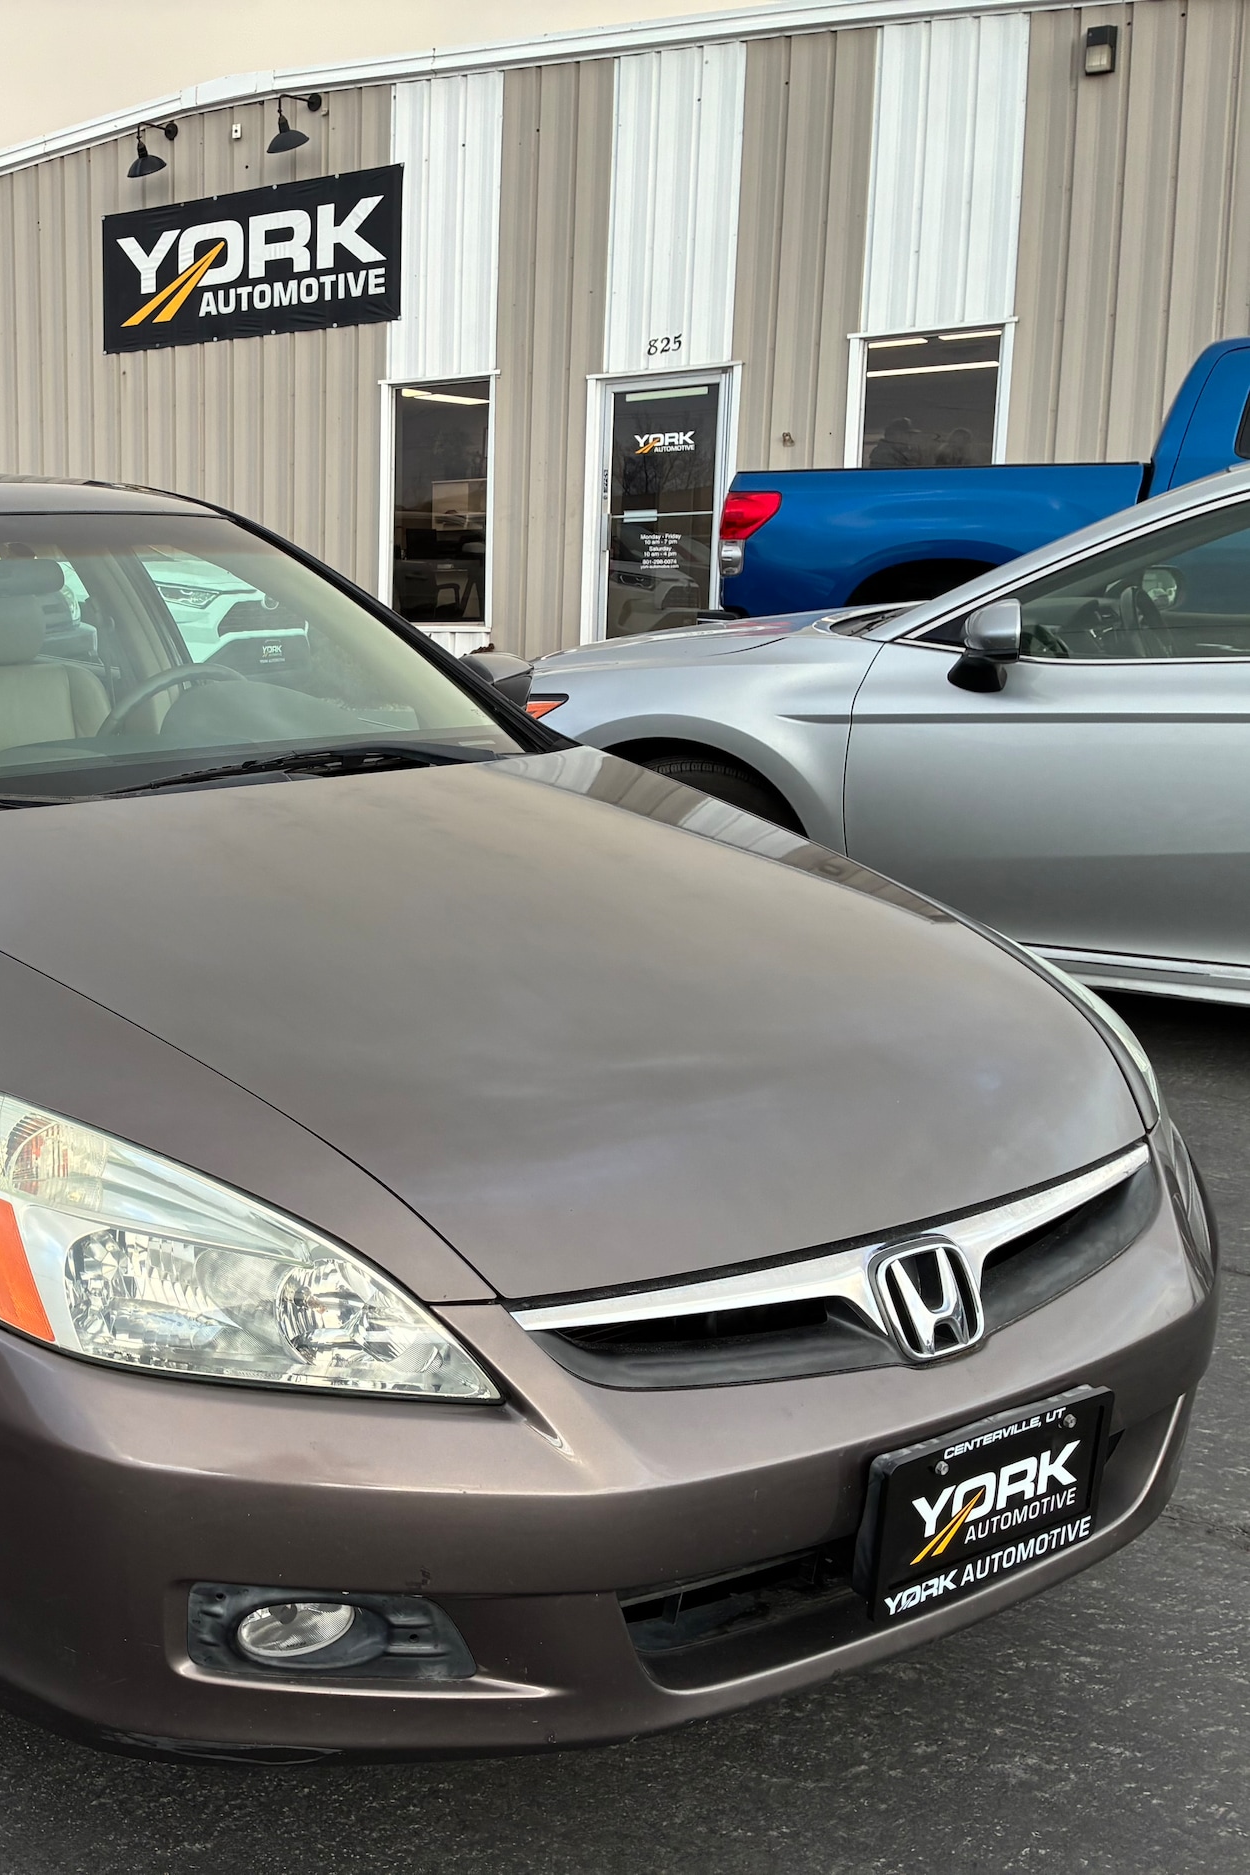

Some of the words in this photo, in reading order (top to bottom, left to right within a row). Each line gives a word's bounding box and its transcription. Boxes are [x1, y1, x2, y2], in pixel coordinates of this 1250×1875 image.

[116, 194, 388, 295] YORK
[199, 267, 386, 318] AUTOMOTIVE
[647, 333, 683, 356] 825
[634, 430, 695, 447] YORK
[654, 444, 695, 453] AUTOMOTIVE
[262, 645, 282, 654] YORK
[943, 1415, 1042, 1460] CENTERVILLE,
[1045, 1407, 1067, 1424] UT
[912, 1439, 1081, 1538] YORK
[964, 1487, 1077, 1545] AUTOMOTIVE
[884, 1568, 958, 1616] YORK
[960, 1516, 1092, 1586] AUTOMOTIVE
